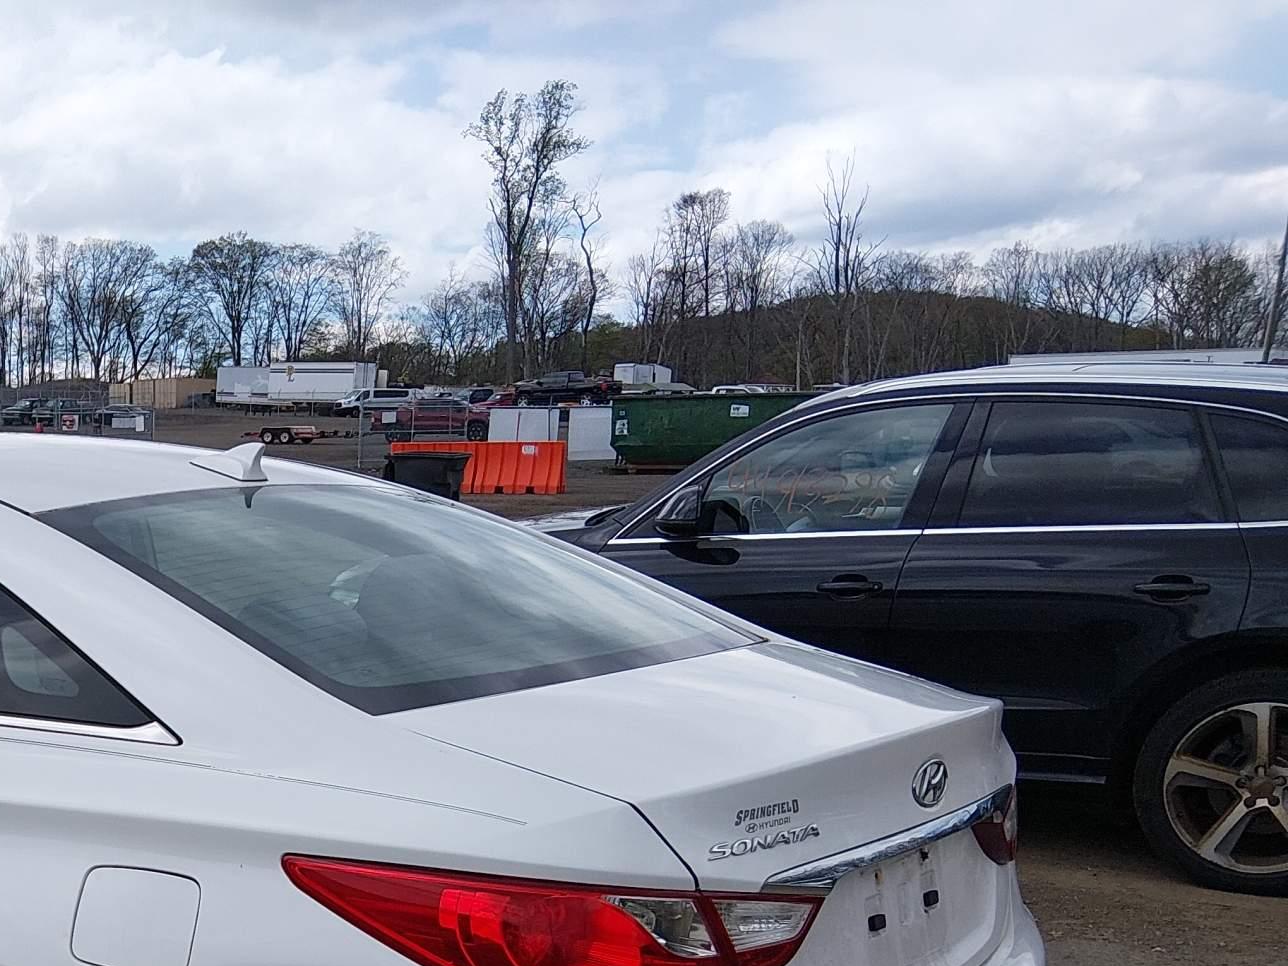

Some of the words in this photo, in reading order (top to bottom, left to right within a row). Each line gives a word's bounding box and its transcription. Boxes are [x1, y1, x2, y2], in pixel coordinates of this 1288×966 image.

[734, 799, 799, 826] SPRINGFIELD
[758, 816, 791, 830] HYUNDAI
[707, 823, 820, 862] SONATA
